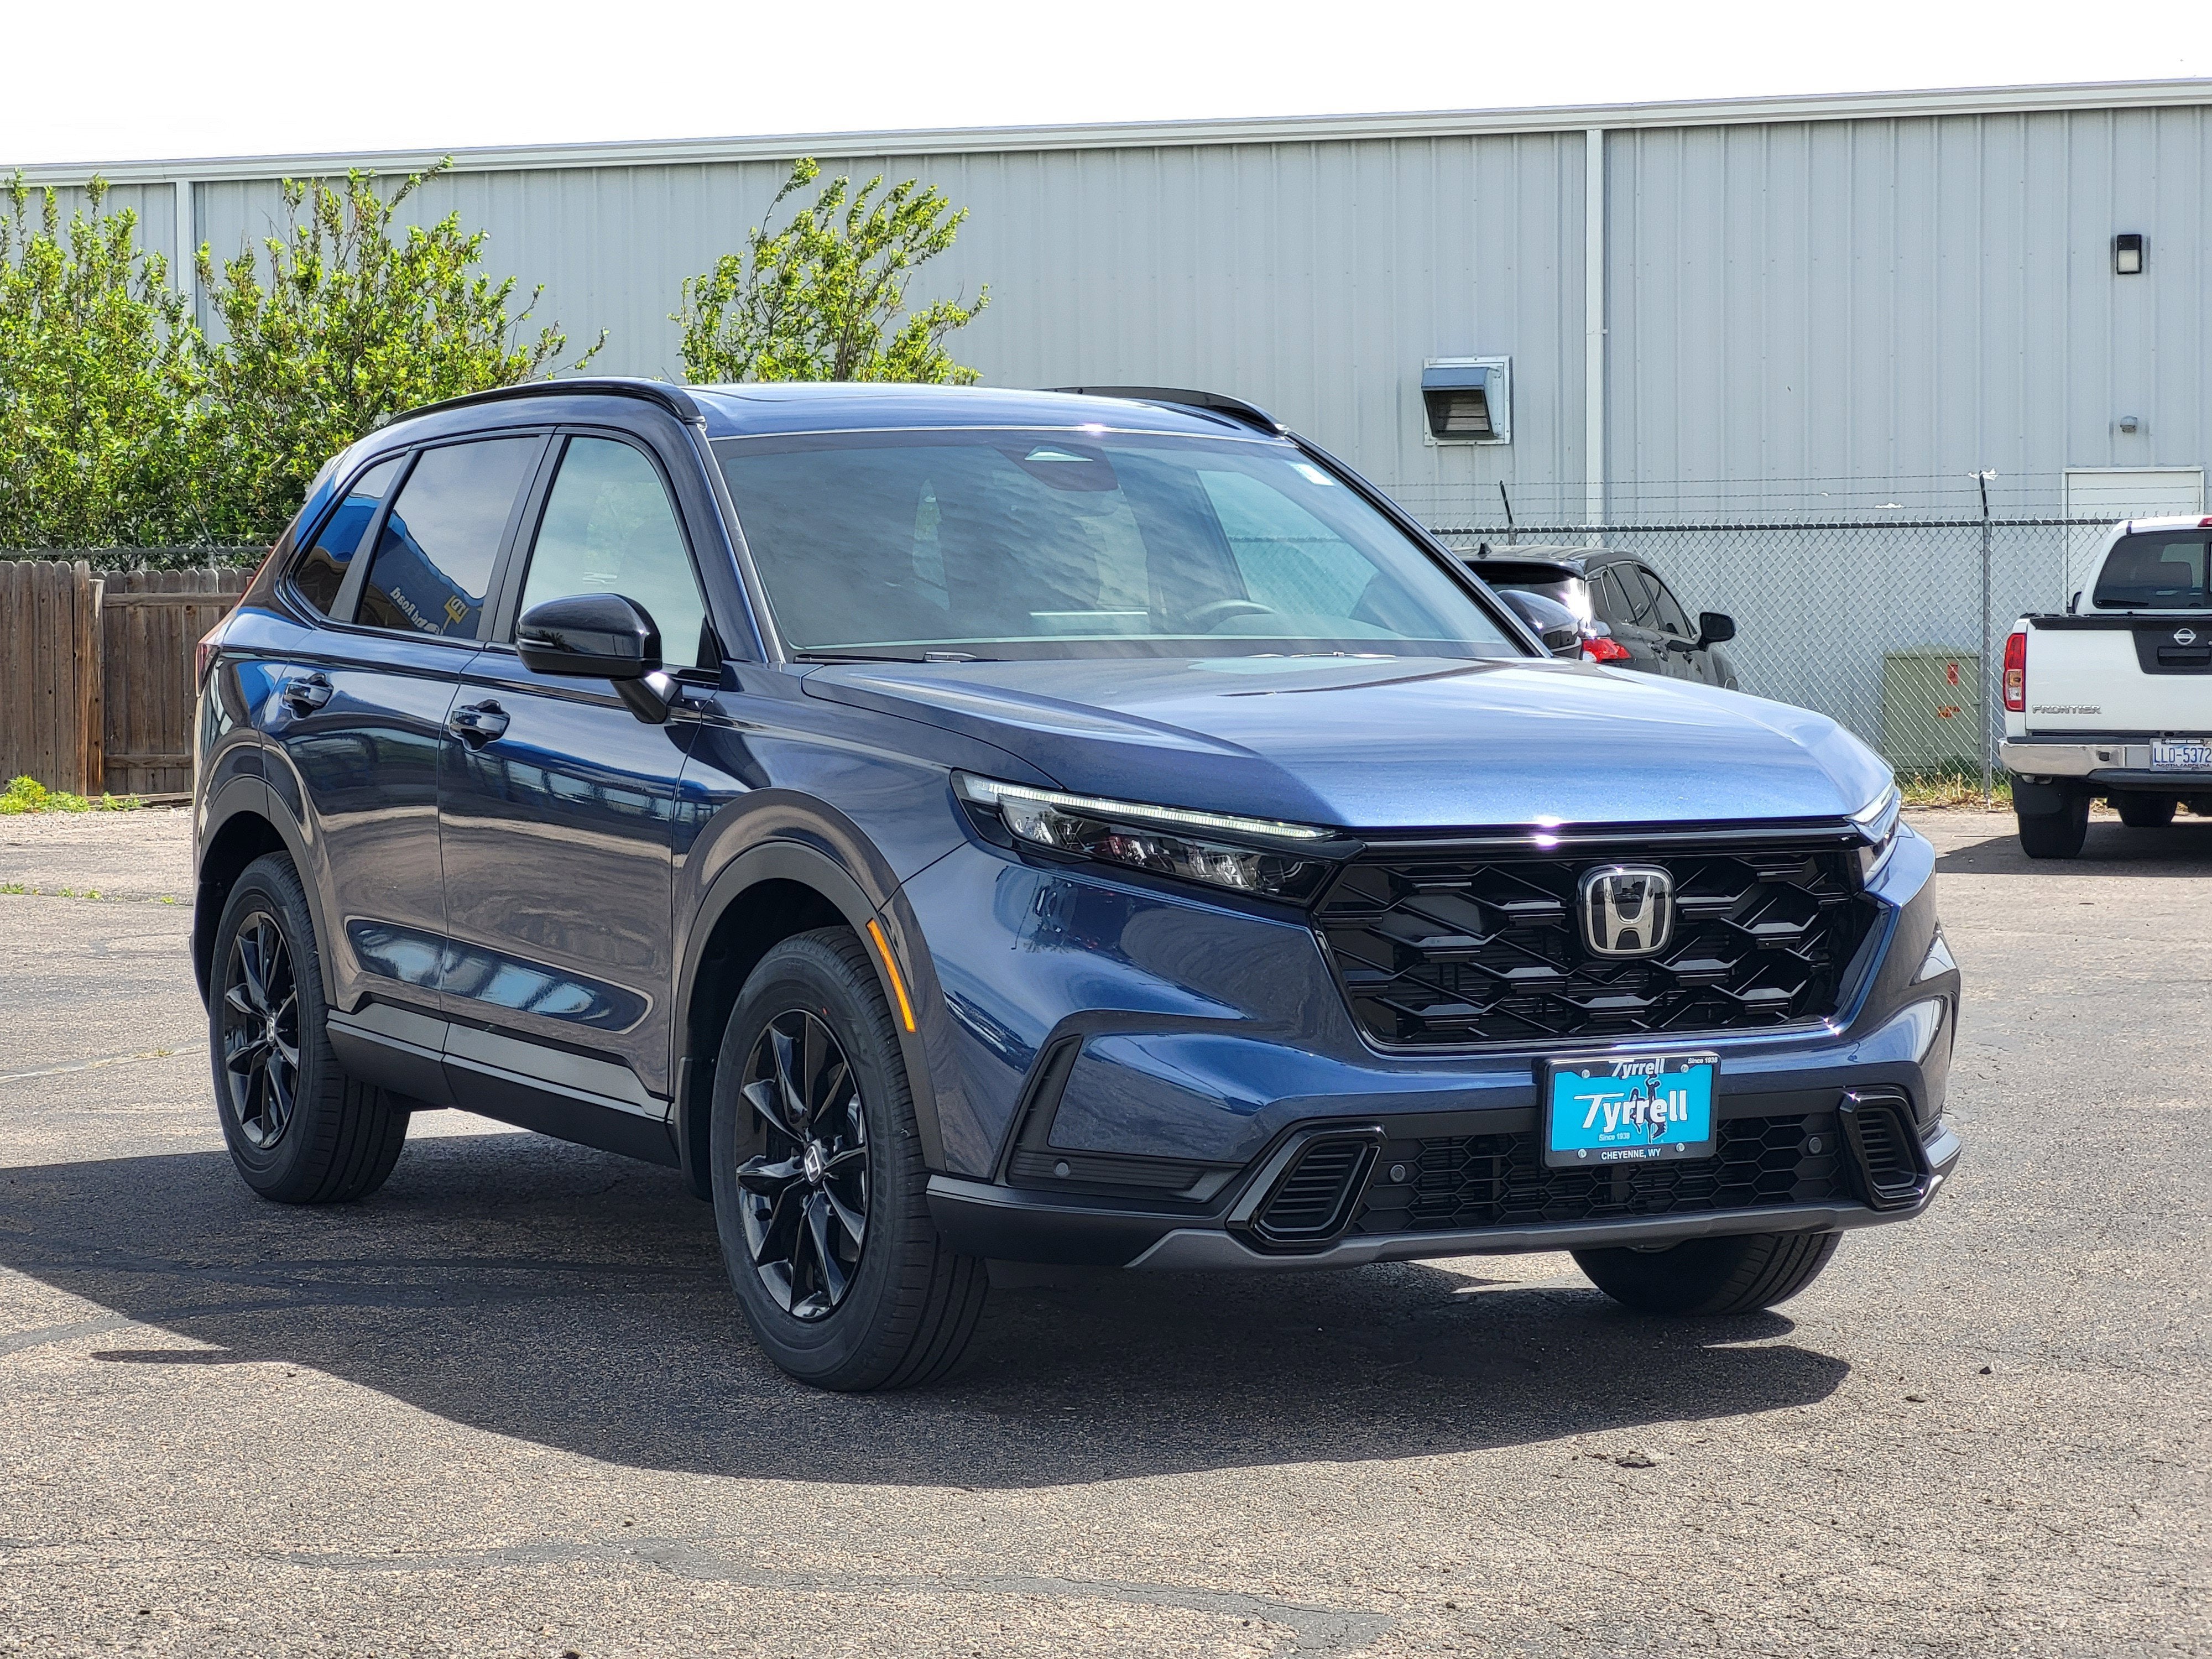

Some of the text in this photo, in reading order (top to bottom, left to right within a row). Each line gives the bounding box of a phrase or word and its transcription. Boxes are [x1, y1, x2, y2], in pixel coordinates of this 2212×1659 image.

[2032, 705, 2101, 714] FRONTIER
[1608, 1058, 1665, 1079] Tyrrell
[1573, 1089, 1688, 1133] Tyrrell
[1598, 1133, 1615, 1141] Since
[1601, 1147, 1661, 1160] CHEYENNE, WY
